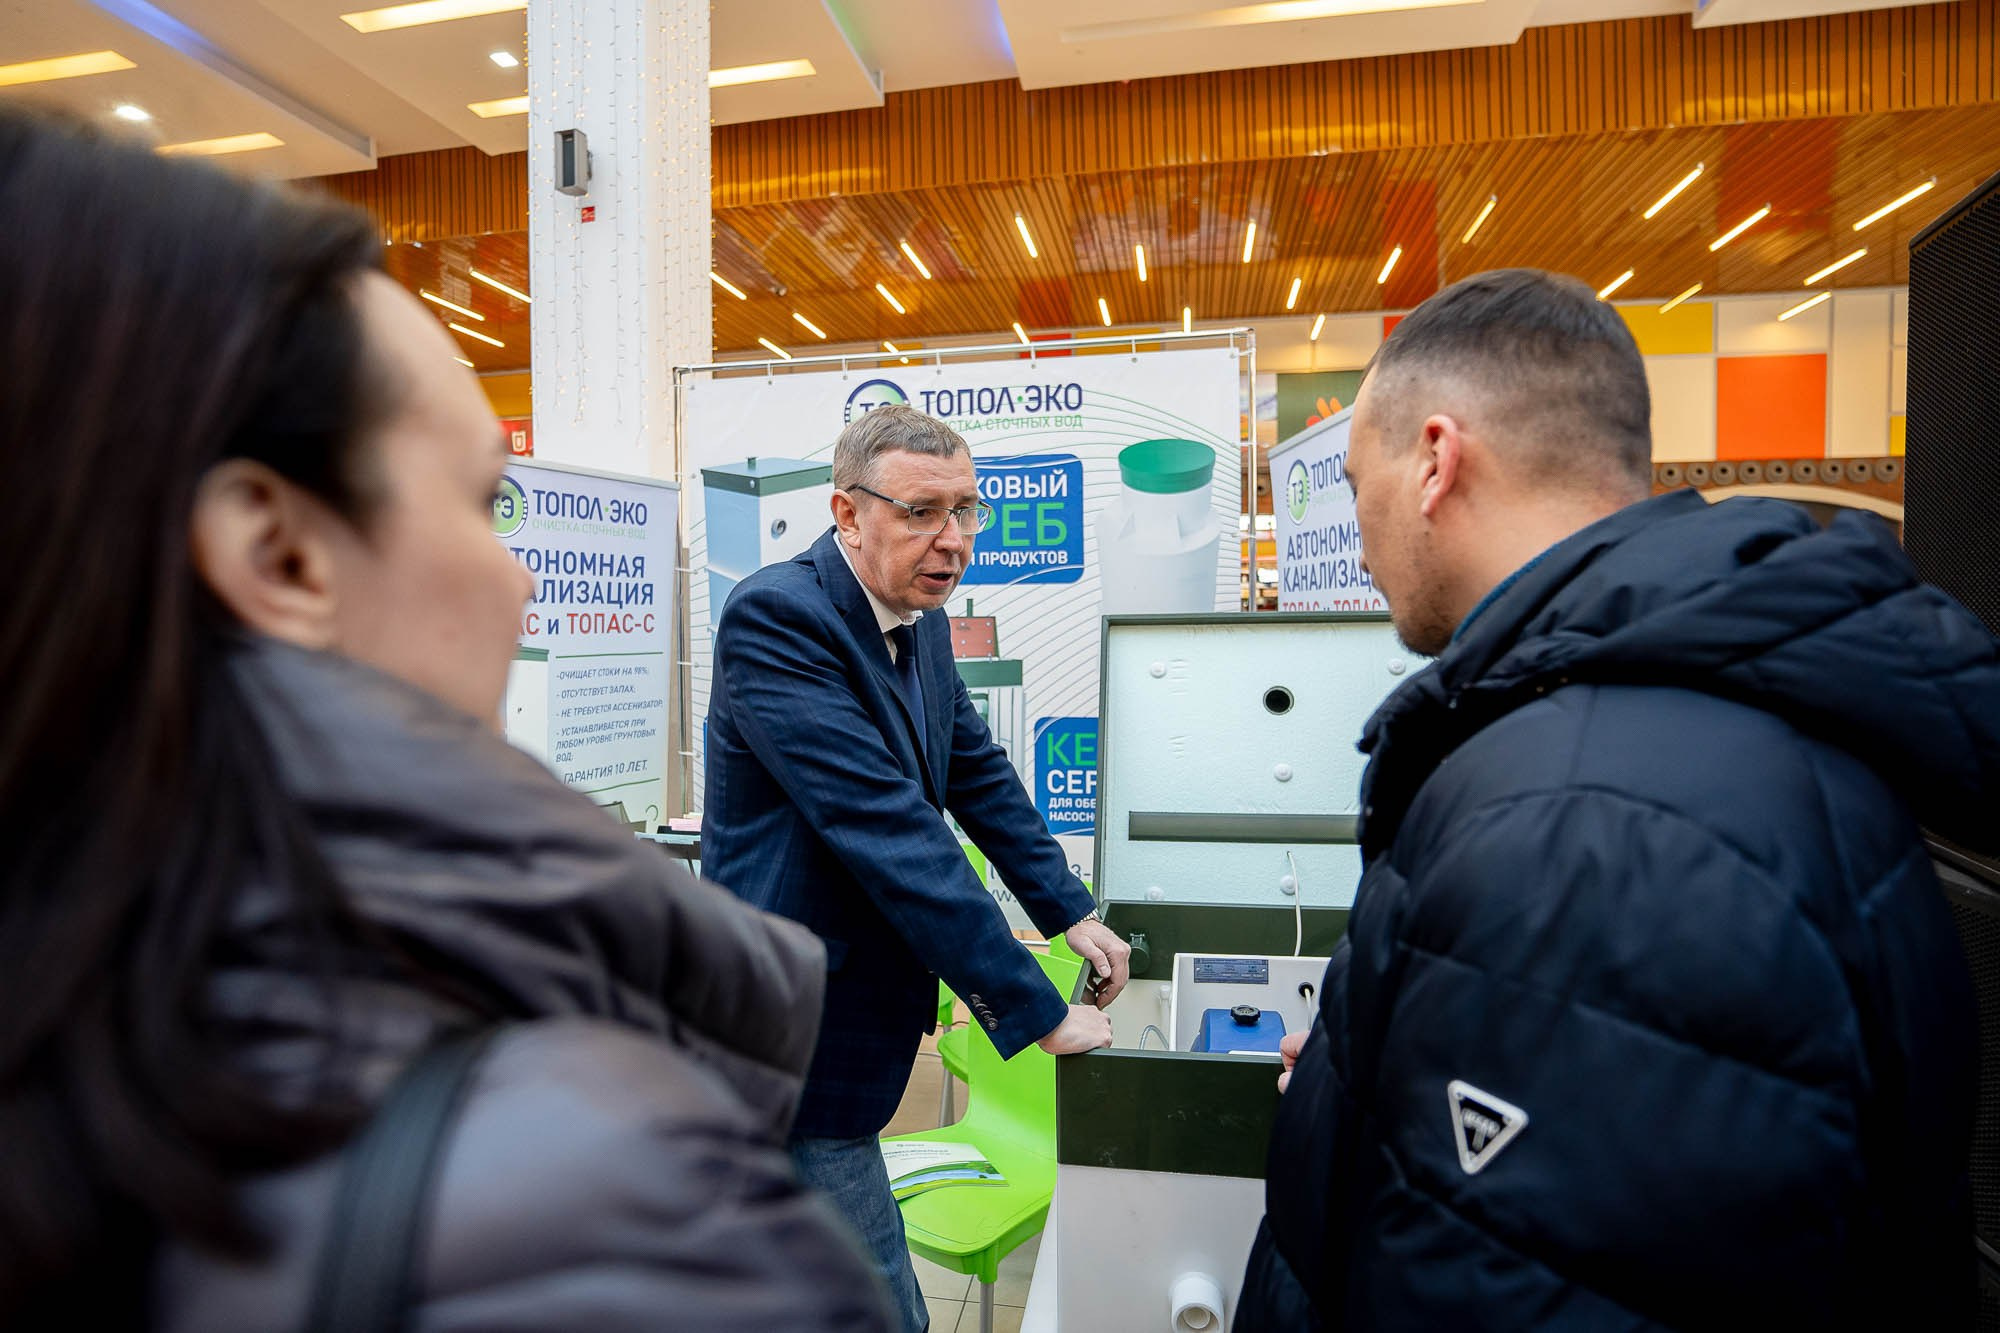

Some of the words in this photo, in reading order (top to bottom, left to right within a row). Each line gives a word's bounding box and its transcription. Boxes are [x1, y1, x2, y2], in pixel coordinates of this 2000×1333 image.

[986, 417, 1050, 431] СТОЧНЫХ
[1054, 414, 1083, 428] ВОД
[1286, 520, 1362, 562] АВТОНОМН
[510, 547, 646, 579] ТОНОМНАЯ
[979, 550, 1068, 568] ПРОДУКТОВ
[1283, 557, 1372, 593] КАНАЛИЗАЦ
[566, 613, 656, 635] ТОПАС-С
[621, 667, 633, 676] НА
[561, 708, 573, 718] НЕ
[561, 720, 630, 736] УСТАНАВЛИВАЕТСЯ
[630, 718, 647, 728] ПРИ
[555, 738, 585, 751] ЛЮБОМ
[585, 733, 613, 745] УРОВНЕ
[613, 728, 657, 741] ГРУНТОВЫХ
[563, 765, 613, 785] ГАРАНТИЯ
[614, 763, 626, 775] 10
[1048, 797, 1073, 810] ДЛЯ
[1048, 811, 1096, 822] НАСОСН
